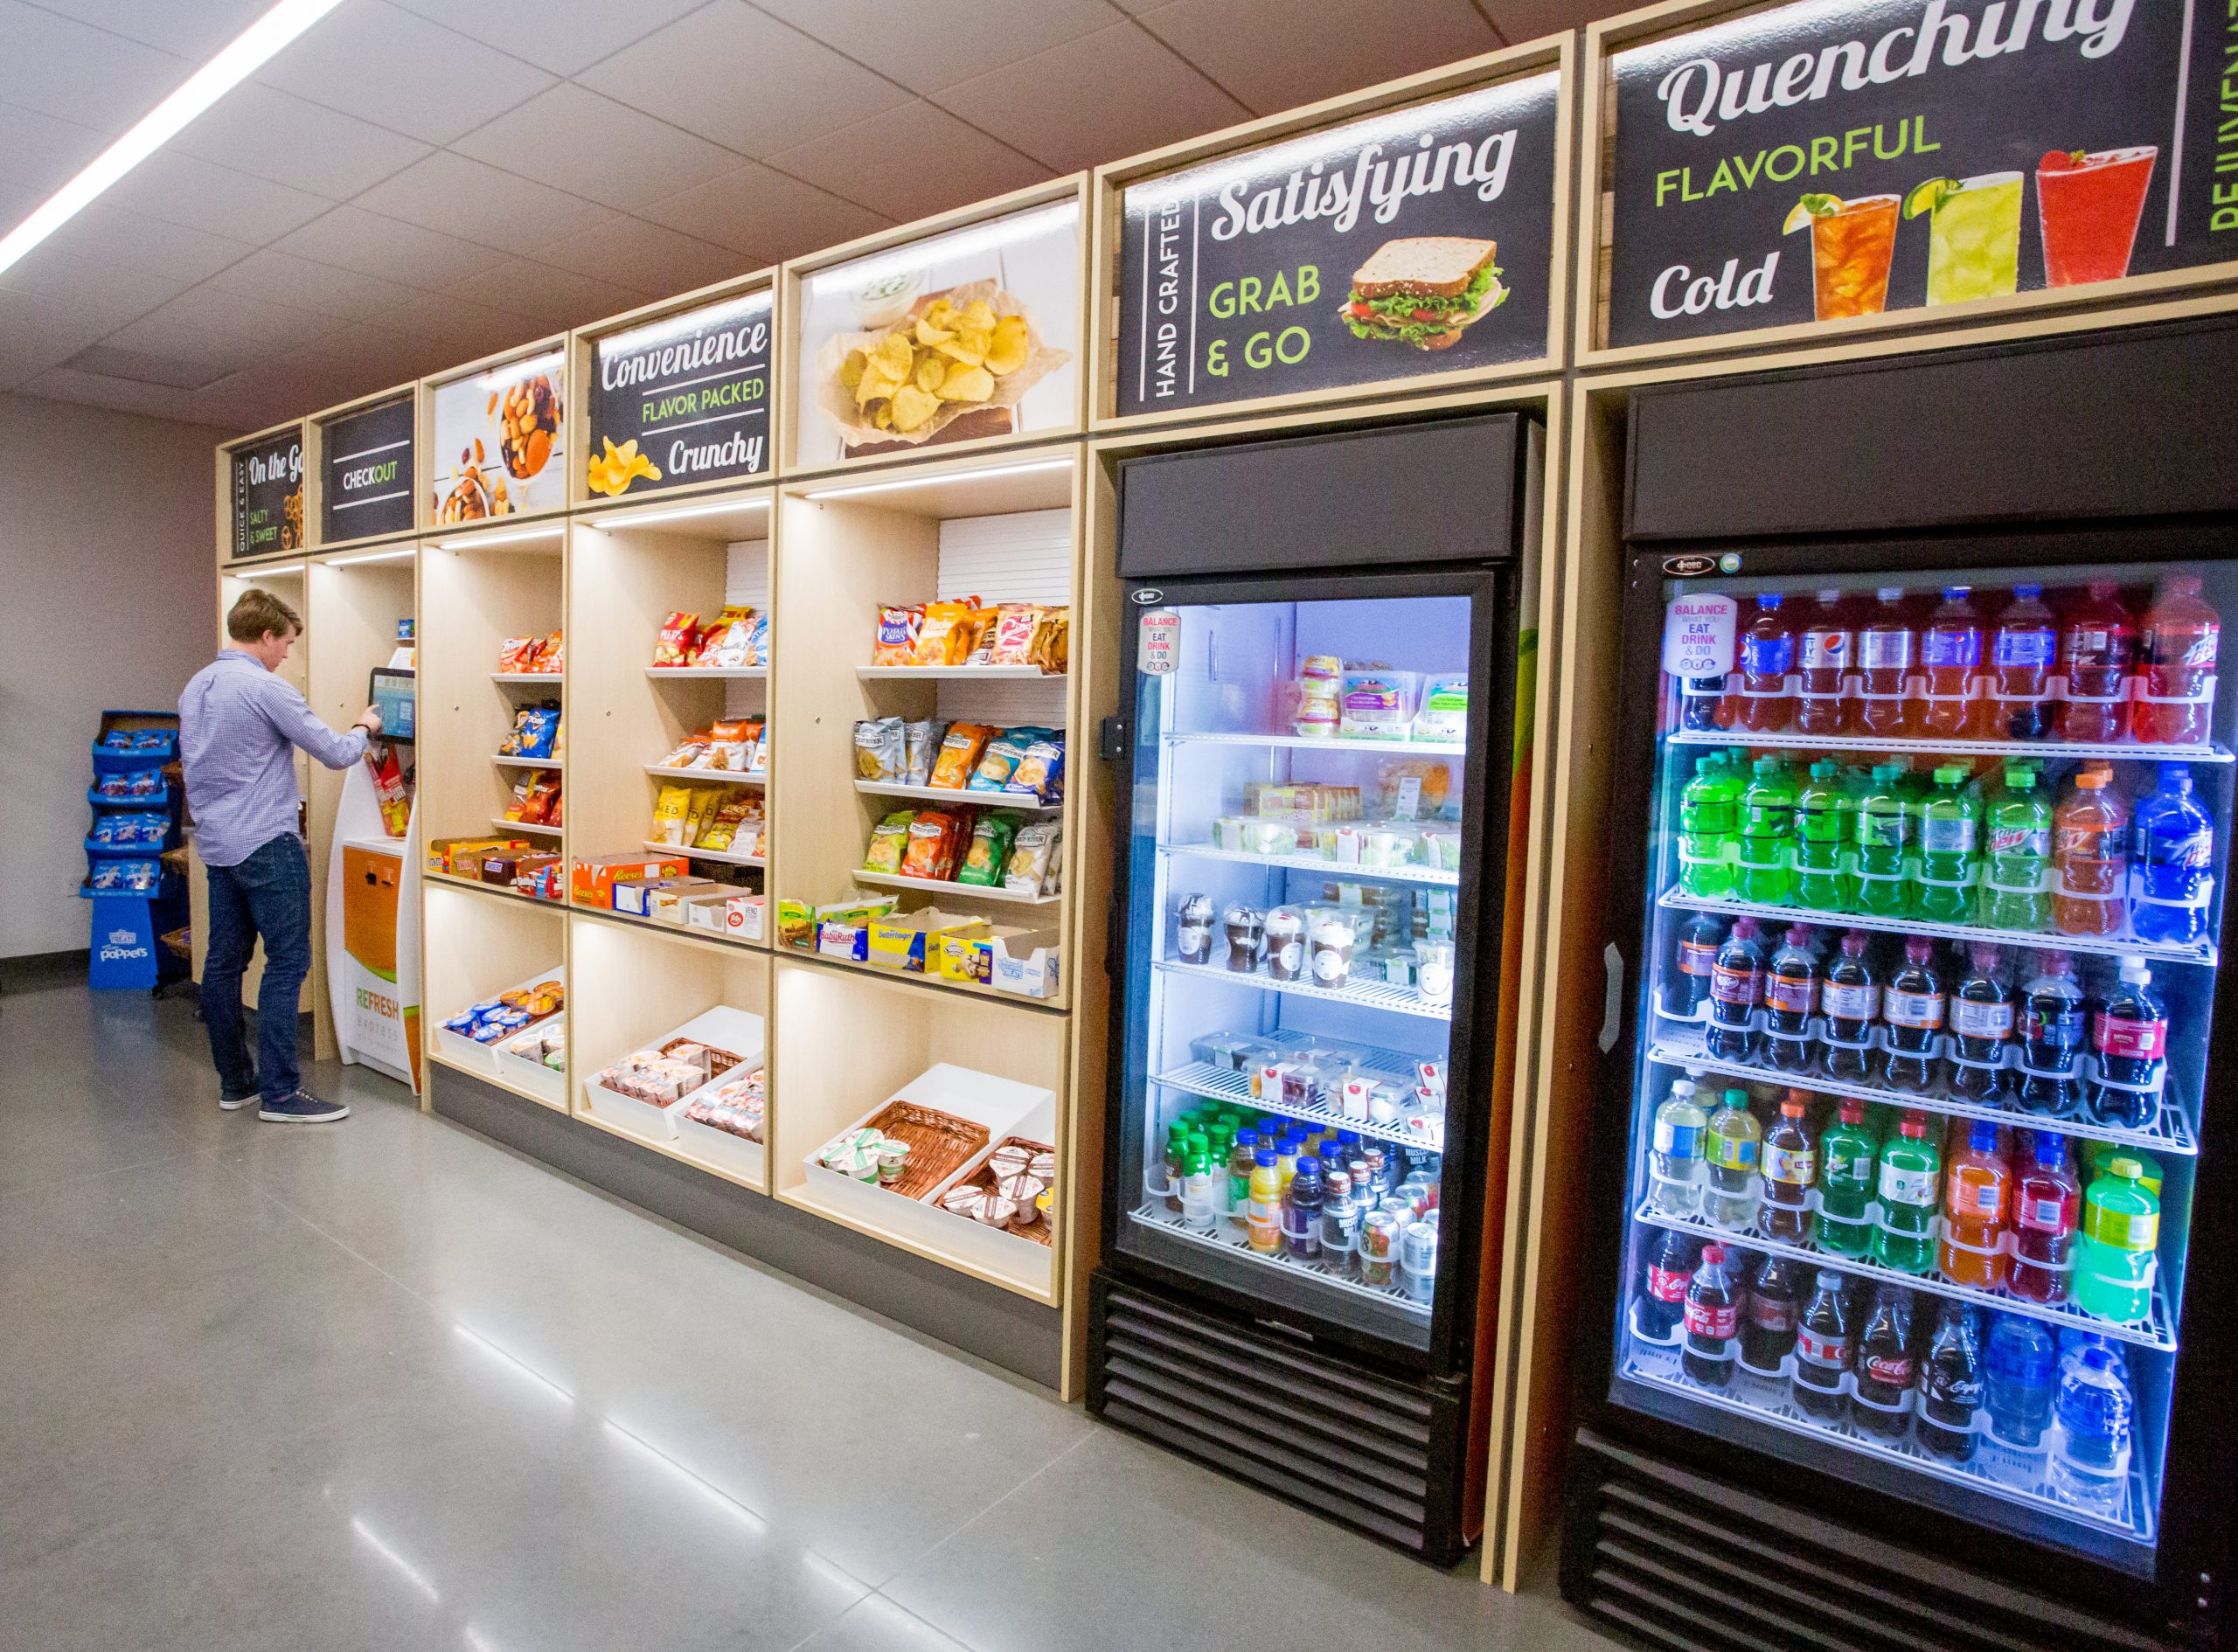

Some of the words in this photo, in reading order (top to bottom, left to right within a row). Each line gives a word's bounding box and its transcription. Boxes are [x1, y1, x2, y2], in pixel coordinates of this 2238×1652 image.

[1658, 0, 2136, 136] Quenching
[1655, 115, 1942, 207] FLAVORFUL
[1211, 128, 1519, 241] Satisfying
[1158, 198, 1180, 315] CRAFTED
[1209, 265, 1320, 319] GRAB
[1650, 250, 1782, 319] Cold
[601, 323, 768, 391] Convenience
[1155, 323, 1177, 398] HAND
[1206, 339, 1229, 377] &
[1244, 326, 1310, 370] GO
[643, 392, 697, 423] FLAVOR
[701, 378, 764, 410] PACKED
[249, 456, 266, 485] On
[268, 452, 287, 481] the
[668, 431, 763, 474] Crunchy
[343, 461, 398, 490] CHECKOUT
[250, 509, 269, 524] SALTY
[256, 526, 278, 543] SWEET
[1143, 617, 1178, 626] BALANCE
[1673, 604, 1727, 615] BALANCE
[1689, 624, 1710, 633] EAT
[1682, 635, 1716, 644] DRINK
[1696, 647, 1711, 656] DO
[356, 986, 399, 1022] REFRESH
